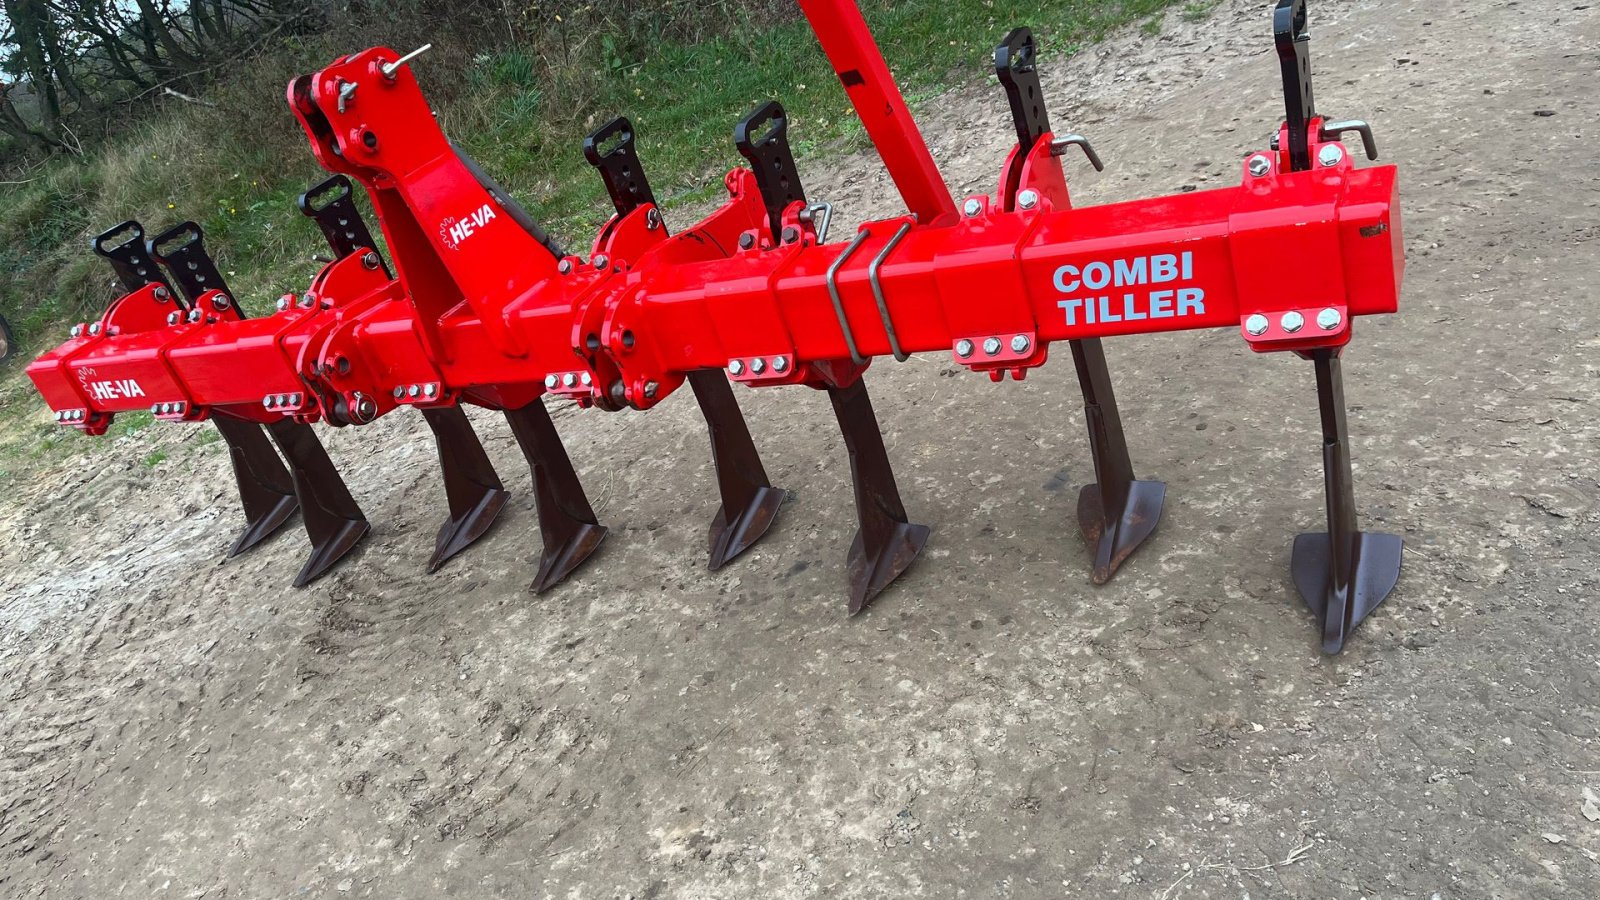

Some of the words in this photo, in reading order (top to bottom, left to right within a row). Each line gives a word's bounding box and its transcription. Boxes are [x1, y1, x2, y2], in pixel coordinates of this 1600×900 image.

[449, 203, 497, 245] HE-VA
[1053, 251, 1193, 293] COMBI
[1057, 287, 1206, 326] TILLER
[91, 379, 146, 400] HE-VA
